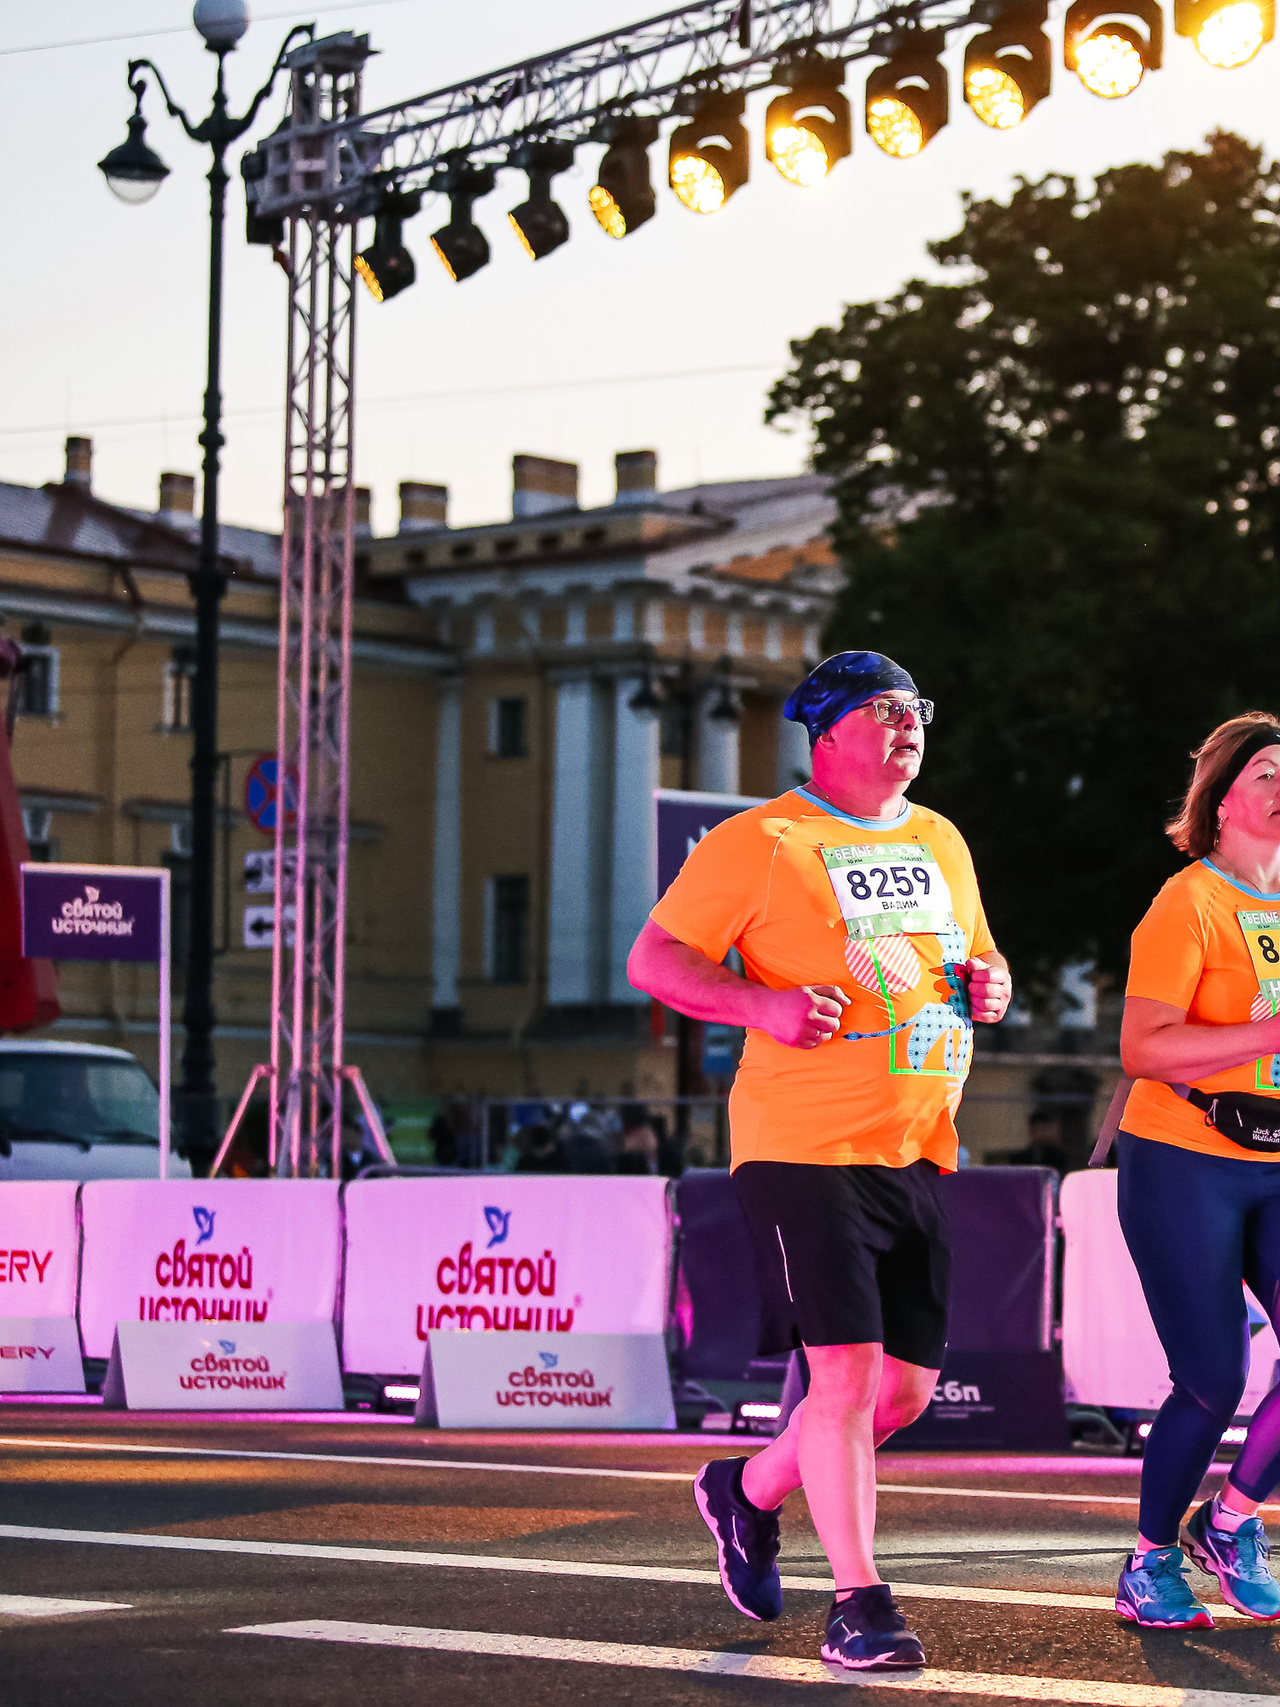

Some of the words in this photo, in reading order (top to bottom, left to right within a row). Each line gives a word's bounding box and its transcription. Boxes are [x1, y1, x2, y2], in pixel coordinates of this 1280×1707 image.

[834, 845, 873, 861] БЕЛЫЕ
[846, 866, 930, 900] 8259
[882, 900, 919, 910] ВАДИМ
[1245, 911, 1280, 924] БЕЛЫЕ
[1253, 1127, 1270, 1135] Jack
